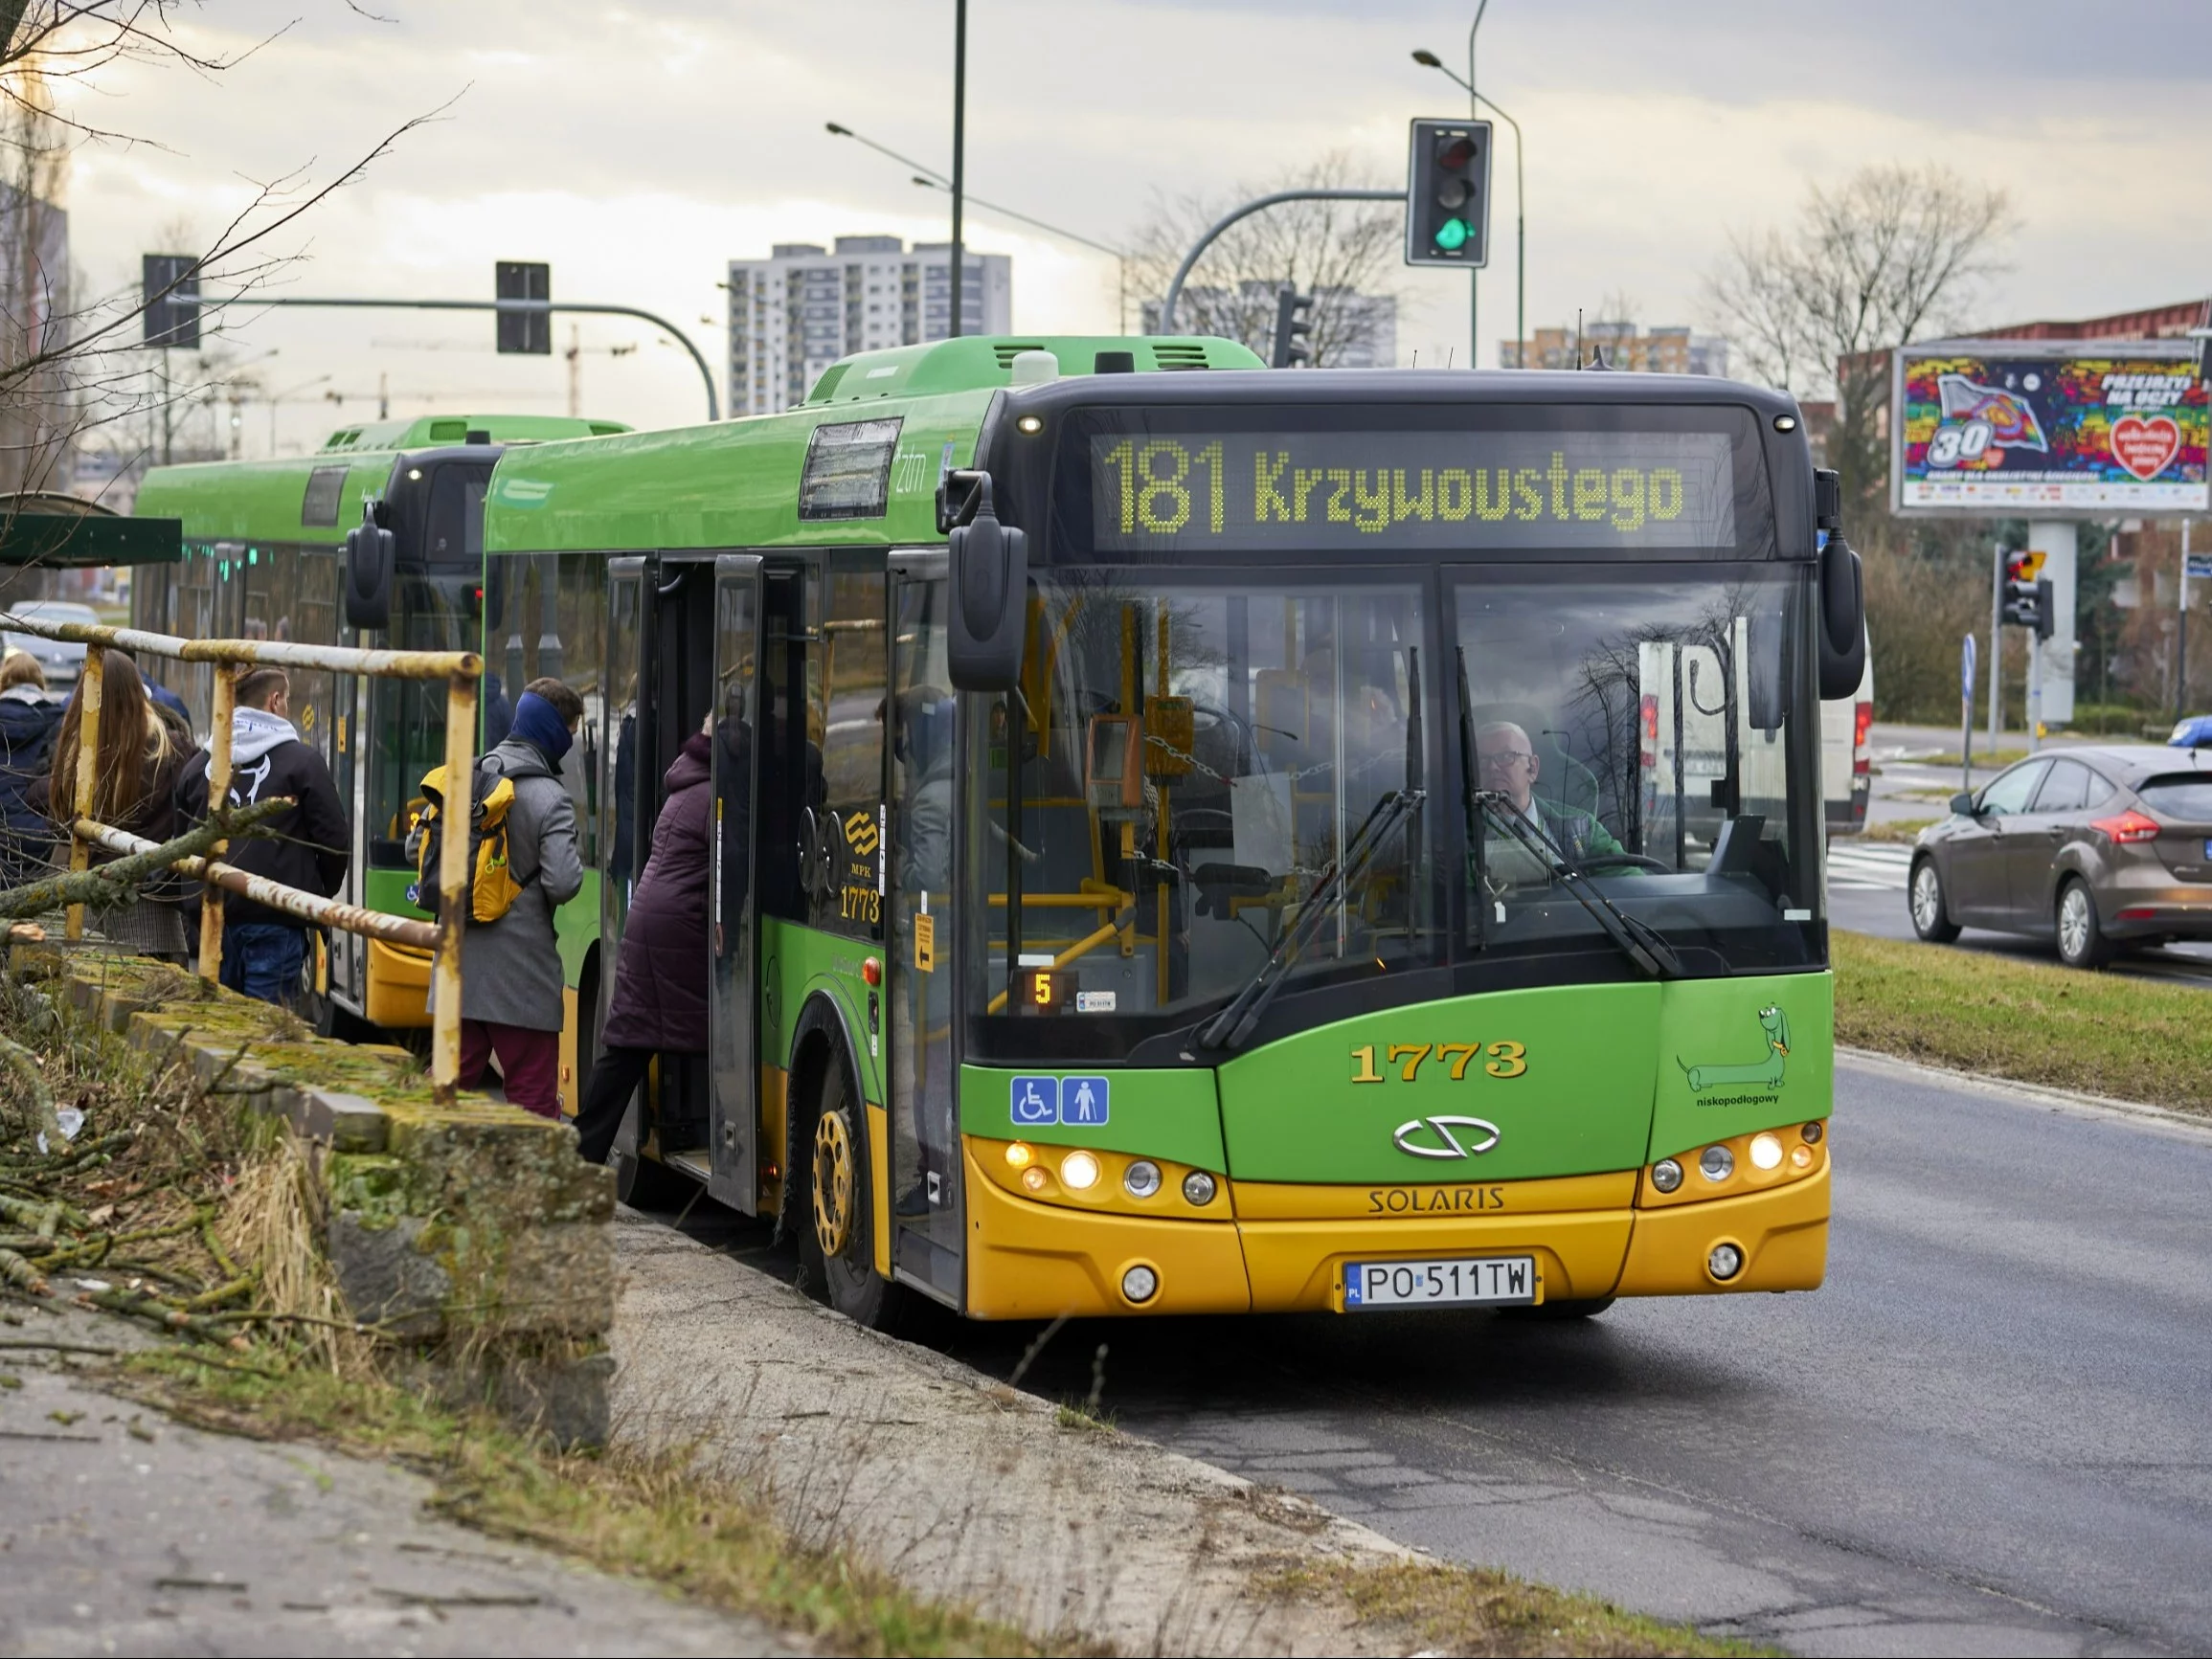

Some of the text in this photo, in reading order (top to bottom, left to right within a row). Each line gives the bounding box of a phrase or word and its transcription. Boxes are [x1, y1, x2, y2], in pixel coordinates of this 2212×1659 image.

[2106, 391, 2183, 406] NA OCZY
[1930, 422, 1993, 465] 30
[896, 444, 927, 494] ztm
[1104, 438, 1683, 533] 181 Krzywoustego
[851, 863, 872, 878] MPK
[841, 885, 880, 924] 1773
[1035, 974, 1051, 1004] 5
[1350, 1041, 1527, 1084] 1773
[1697, 1093, 1779, 1107] niskopodłogowy
[1368, 1187, 1504, 1213] SOLARIS
[1348, 1263, 1525, 1300] PL PO 511TW
